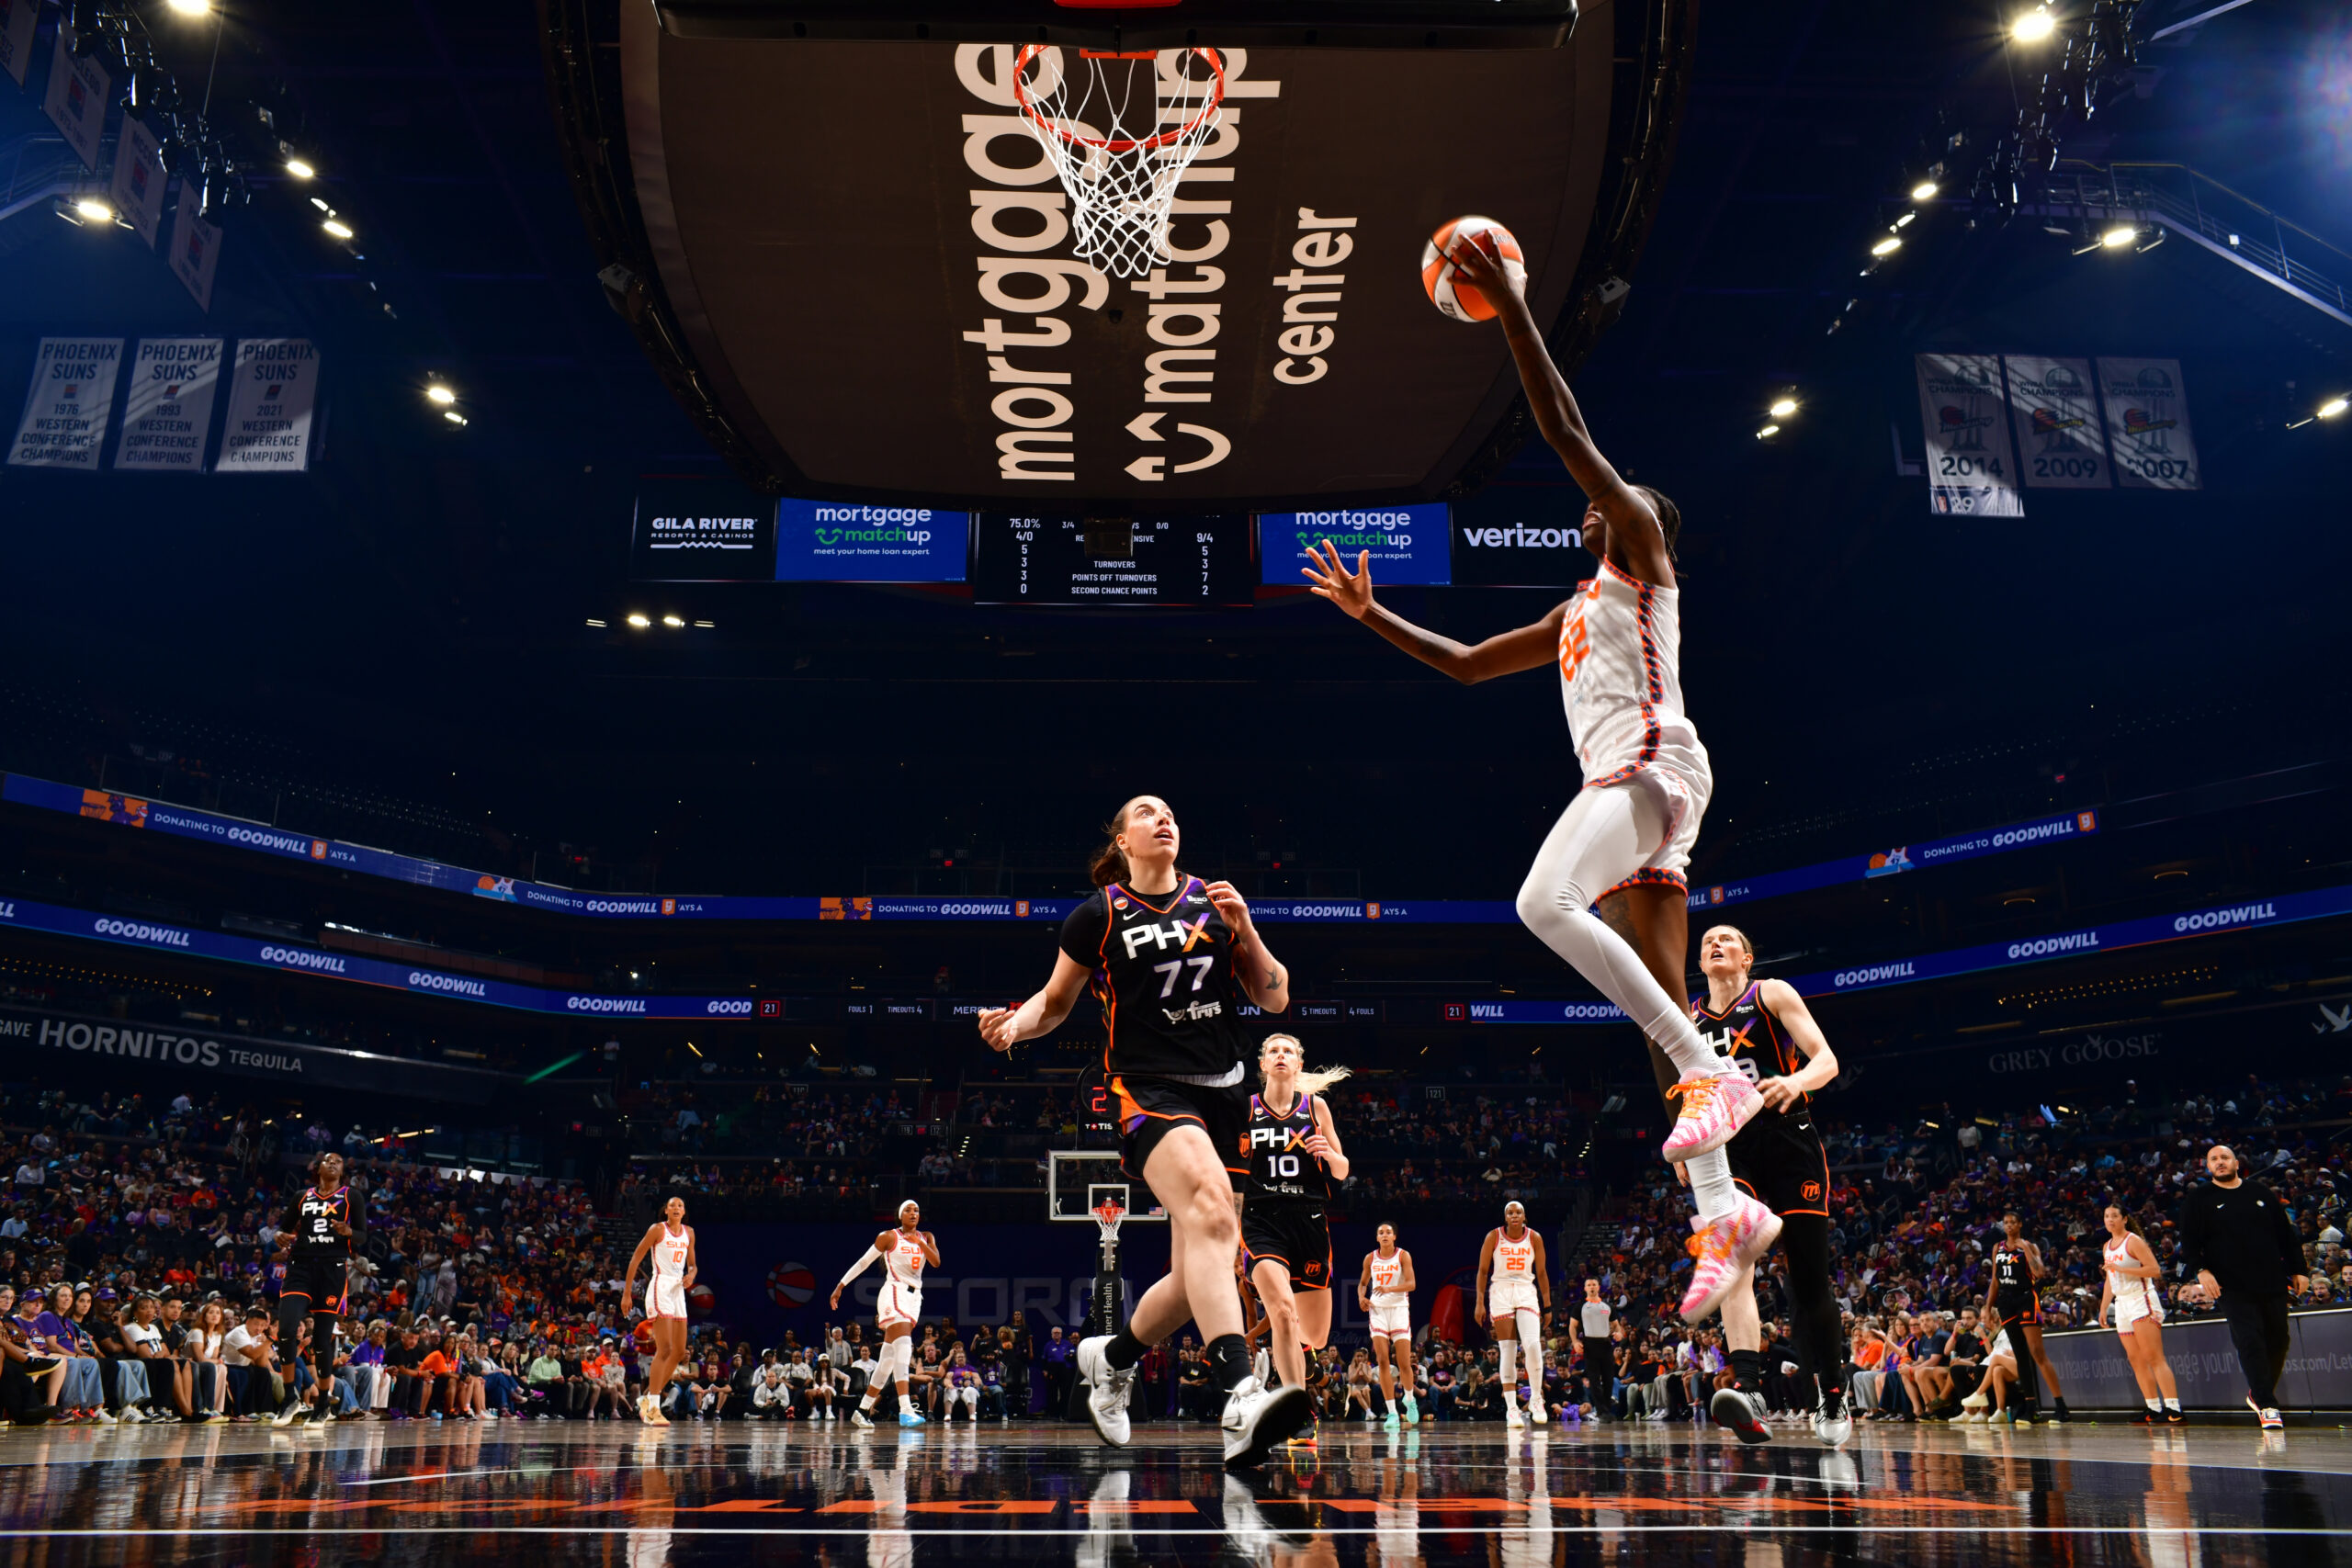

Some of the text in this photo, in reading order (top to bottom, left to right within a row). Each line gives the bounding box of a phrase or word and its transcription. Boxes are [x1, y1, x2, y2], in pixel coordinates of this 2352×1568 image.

[1130, 47, 1282, 402] matchup
[955, 43, 1110, 481] mortgage
[1273, 207, 1357, 385] center
[42, 344, 117, 361] PHOENIX
[141, 344, 216, 361] PHOENIX
[243, 344, 314, 361] PHOENIX
[52, 363, 96, 380] SUNS
[152, 365, 197, 380] SUNS
[254, 365, 297, 380] SUNS
[1929, 385, 1993, 396] CHAMPIONS
[2020, 388, 2084, 398] CHAMPIONS
[2112, 388, 2176, 398] CHAMPIONS
[54, 403, 79, 414] 1976
[155, 404, 181, 415] 1993
[257, 404, 283, 415] 2021
[35, 419, 89, 431] WESTERN
[139, 420, 192, 432] WESTERN
[242, 420, 292, 432] WESTERN
[21, 433, 96, 446] CONFERENCE
[126, 435, 199, 448] CONFERENCE
[230, 434, 301, 448] CONFERENCE
[20, 447, 89, 463] CHAMPIONS
[125, 449, 192, 464] CHAMPIONS
[231, 449, 295, 464] CHAMPIONS
[1941, 457, 2004, 478] 2014
[2033, 458, 2098, 479] 2009
[2128, 458, 2188, 479] 2007
[815, 505, 932, 527] mortgage
[1295, 510, 1411, 530] mortgage
[651, 517, 755, 530] GILA RIVER
[1009, 518, 1041, 529] 75.0%
[1061, 521, 1075, 530] 3/4
[1156, 522, 1169, 530] 0/0
[844, 526, 932, 546] matchup
[1015, 531, 1034, 542] 4/0
[1196, 533, 1214, 543] 9/4
[1327, 531, 1412, 550] matchup
[1464, 523, 1582, 547] verizon
[902, 548, 930, 557] expert
[1021, 544, 1028, 555] 5
[1202, 546, 1208, 556] 5
[1385, 552, 1412, 560] expert
[1021, 557, 1027, 568] 3
[1093, 560, 1136, 569] TURNOVERS
[1202, 558, 1208, 569] 3
[1021, 570, 1027, 581] 3
[1072, 573, 1158, 582] POINTS OFF TURNOVERS
[1202, 571, 1208, 582] 7
[1020, 583, 1027, 593] 0
[1071, 586, 1158, 595] SECOND CHANCE POINTS
[1202, 585, 1208, 595] 2
[154, 812, 209, 832] DONATING
[211, 825, 225, 835] TO
[228, 827, 307, 854] GOODWILL
[329, 850, 348, 861] AYS
[1923, 820, 2074, 859] DONATING TO GOODWILL
[1725, 887, 1743, 897] AYS
[526, 890, 571, 908] DONATING
[571, 899, 583, 908] TO
[586, 899, 658, 914] GOODWILL
[878, 905, 925, 913] DONATING
[926, 905, 938, 913] TO
[940, 903, 1011, 916] GOODWILL
[1032, 906, 1049, 914] AYS
[1250, 907, 1276, 915] ATING
[1278, 907, 1289, 915] TO
[1292, 906, 1363, 918] GOODWILL
[2175, 902, 2277, 932] GOODWILL
[94, 918, 190, 947] GOODWILL
[1122, 912, 1215, 960] PHX
[2007, 931, 2099, 959] GOODWILL
[260, 946, 345, 973] GOODWILL
[1154, 955, 1214, 998] 77
[1834, 962, 1916, 987] GOODWILL
[409, 972, 485, 997] GOODWILL
[567, 996, 647, 1013] GOODWILL
[707, 1000, 752, 1014] GOOD
[764, 1003, 776, 1014] 21
[848, 1005, 866, 1013] FOULS
[888, 1004, 922, 1014] TIMEOUTS 4
[1187, 1000, 1222, 1021] fry's
[1236, 1006, 1261, 1016] UN
[1349, 1006, 1374, 1016] 4 FOULS
[1301, 1006, 1337, 1017] 5 TIMEOUTS
[1448, 1006, 1460, 1017] 21
[1471, 1005, 1505, 1018] WILL
[1565, 1005, 1624, 1018] GOODW
[1702, 1017, 1758, 1057] HX
[38, 1019, 220, 1067] HORNITOS
[228, 1049, 302, 1073] TEQUILA
[1988, 1033, 2160, 1074] GREY GOOSE
[1250, 1125, 1311, 1152] PHX
[1268, 1155, 1299, 1178] 10
[302, 1200, 344, 1217] PHX
[313, 1218, 328, 1233] 2
[666, 1241, 689, 1249] SUN
[1499, 1247, 1531, 1256] SUN
[673, 1250, 684, 1263] 10
[911, 1257, 921, 1269] 8
[1996, 1253, 2021, 1264] PHX
[1373, 1264, 1399, 1272] SUN
[1506, 1258, 1525, 1270] 25
[2002, 1265, 2012, 1277] 11
[1376, 1272, 1394, 1285] 47
[1102, 1282, 1113, 1314] Health
[2068, 1356, 2089, 1380] have
[2091, 1356, 2134, 1384] options
[2166, 1351, 2199, 1382] nage
[2202, 1351, 2234, 1382] your
